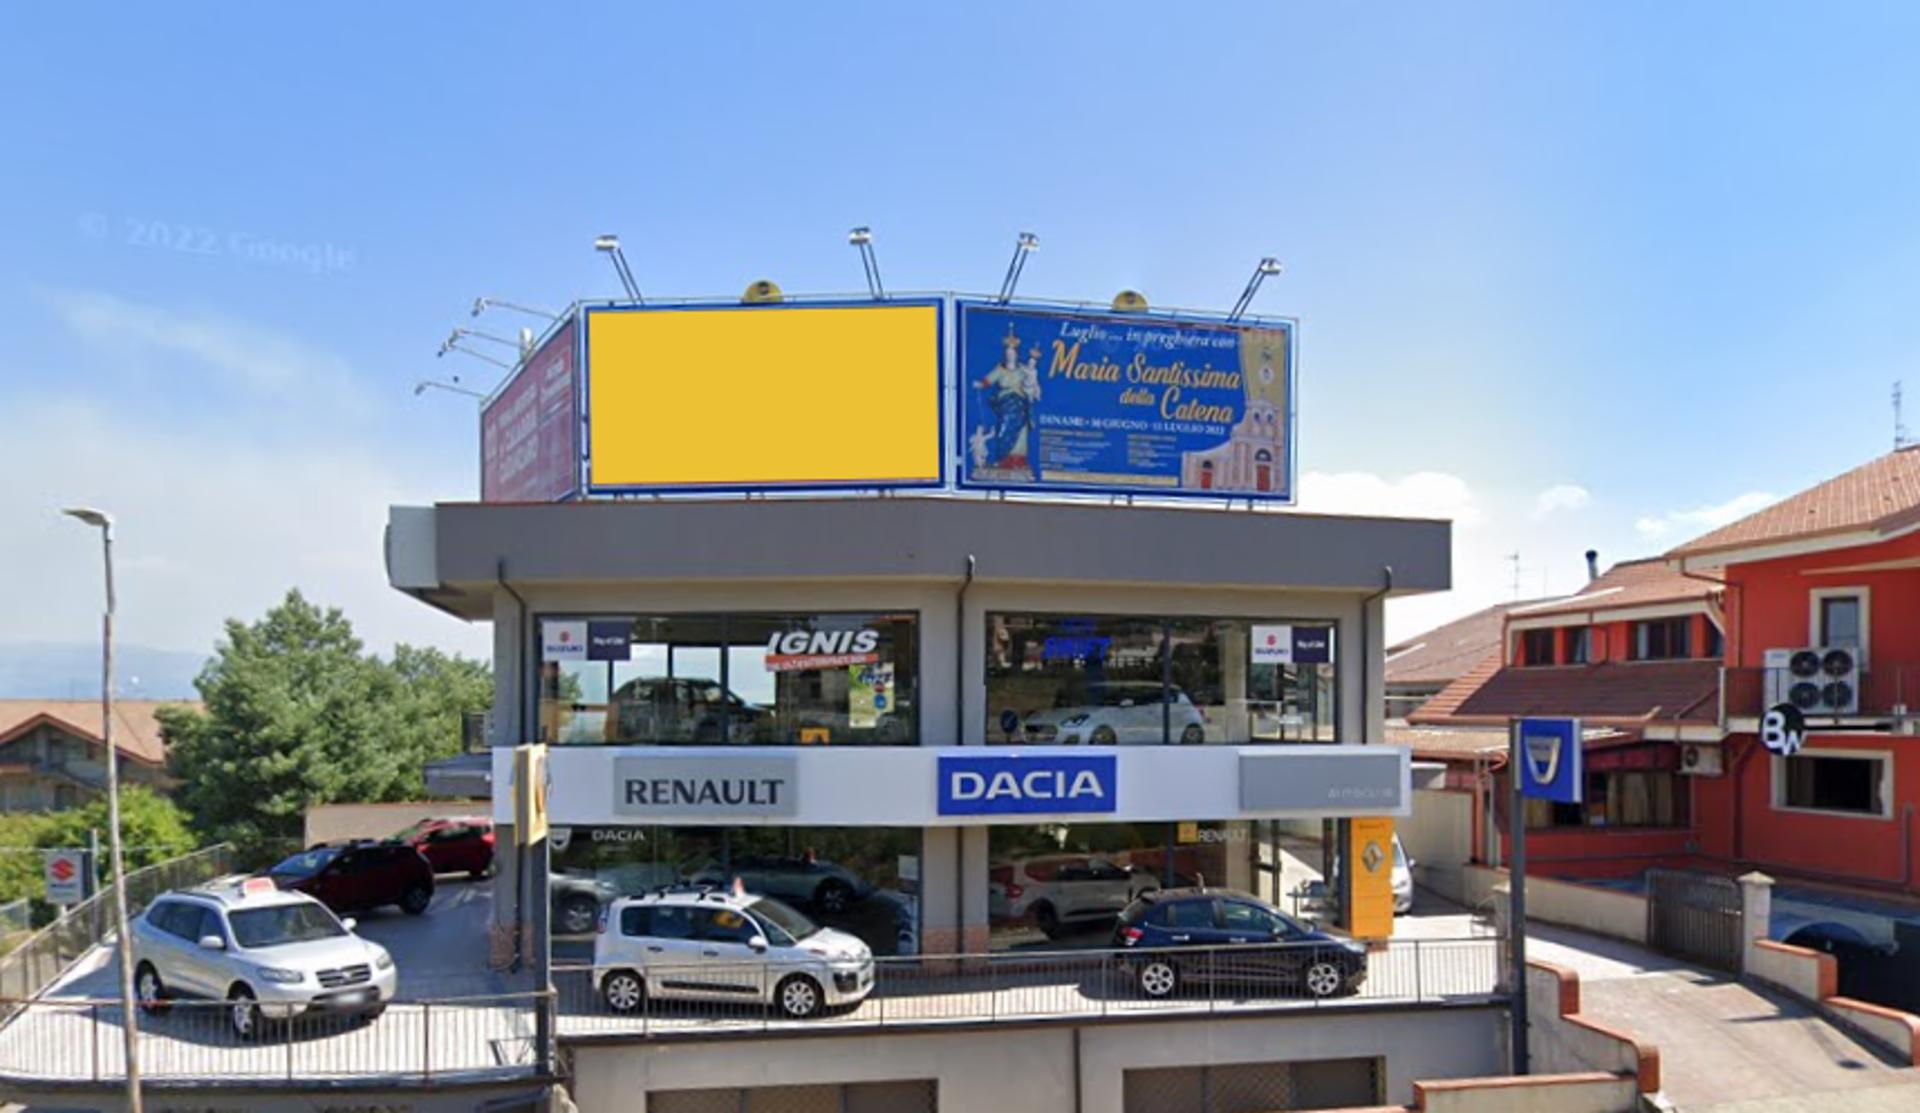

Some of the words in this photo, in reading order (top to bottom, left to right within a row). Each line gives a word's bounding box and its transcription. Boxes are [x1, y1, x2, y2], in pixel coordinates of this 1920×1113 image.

[1060, 322, 1106, 344] Luglio
[1126, 327, 1140, 342] in
[1142, 330, 1208, 350] preghiera
[1211, 337, 1236, 349] con
[1049, 339, 1121, 383] Maria
[1127, 353, 1241, 389] Santissima
[1120, 387, 1154, 406] della
[1160, 386, 1233, 424] Catena
[1103, 418, 1147, 431] GIUGNO
[1164, 422, 1203, 433] LUGLIO
[768, 630, 880, 655] IGNIS
[625, 778, 784, 805] RENAULT
[951, 770, 1104, 800] DACIA
[591, 829, 645, 841] DACIA
[1198, 828, 1248, 842] RENAULT
